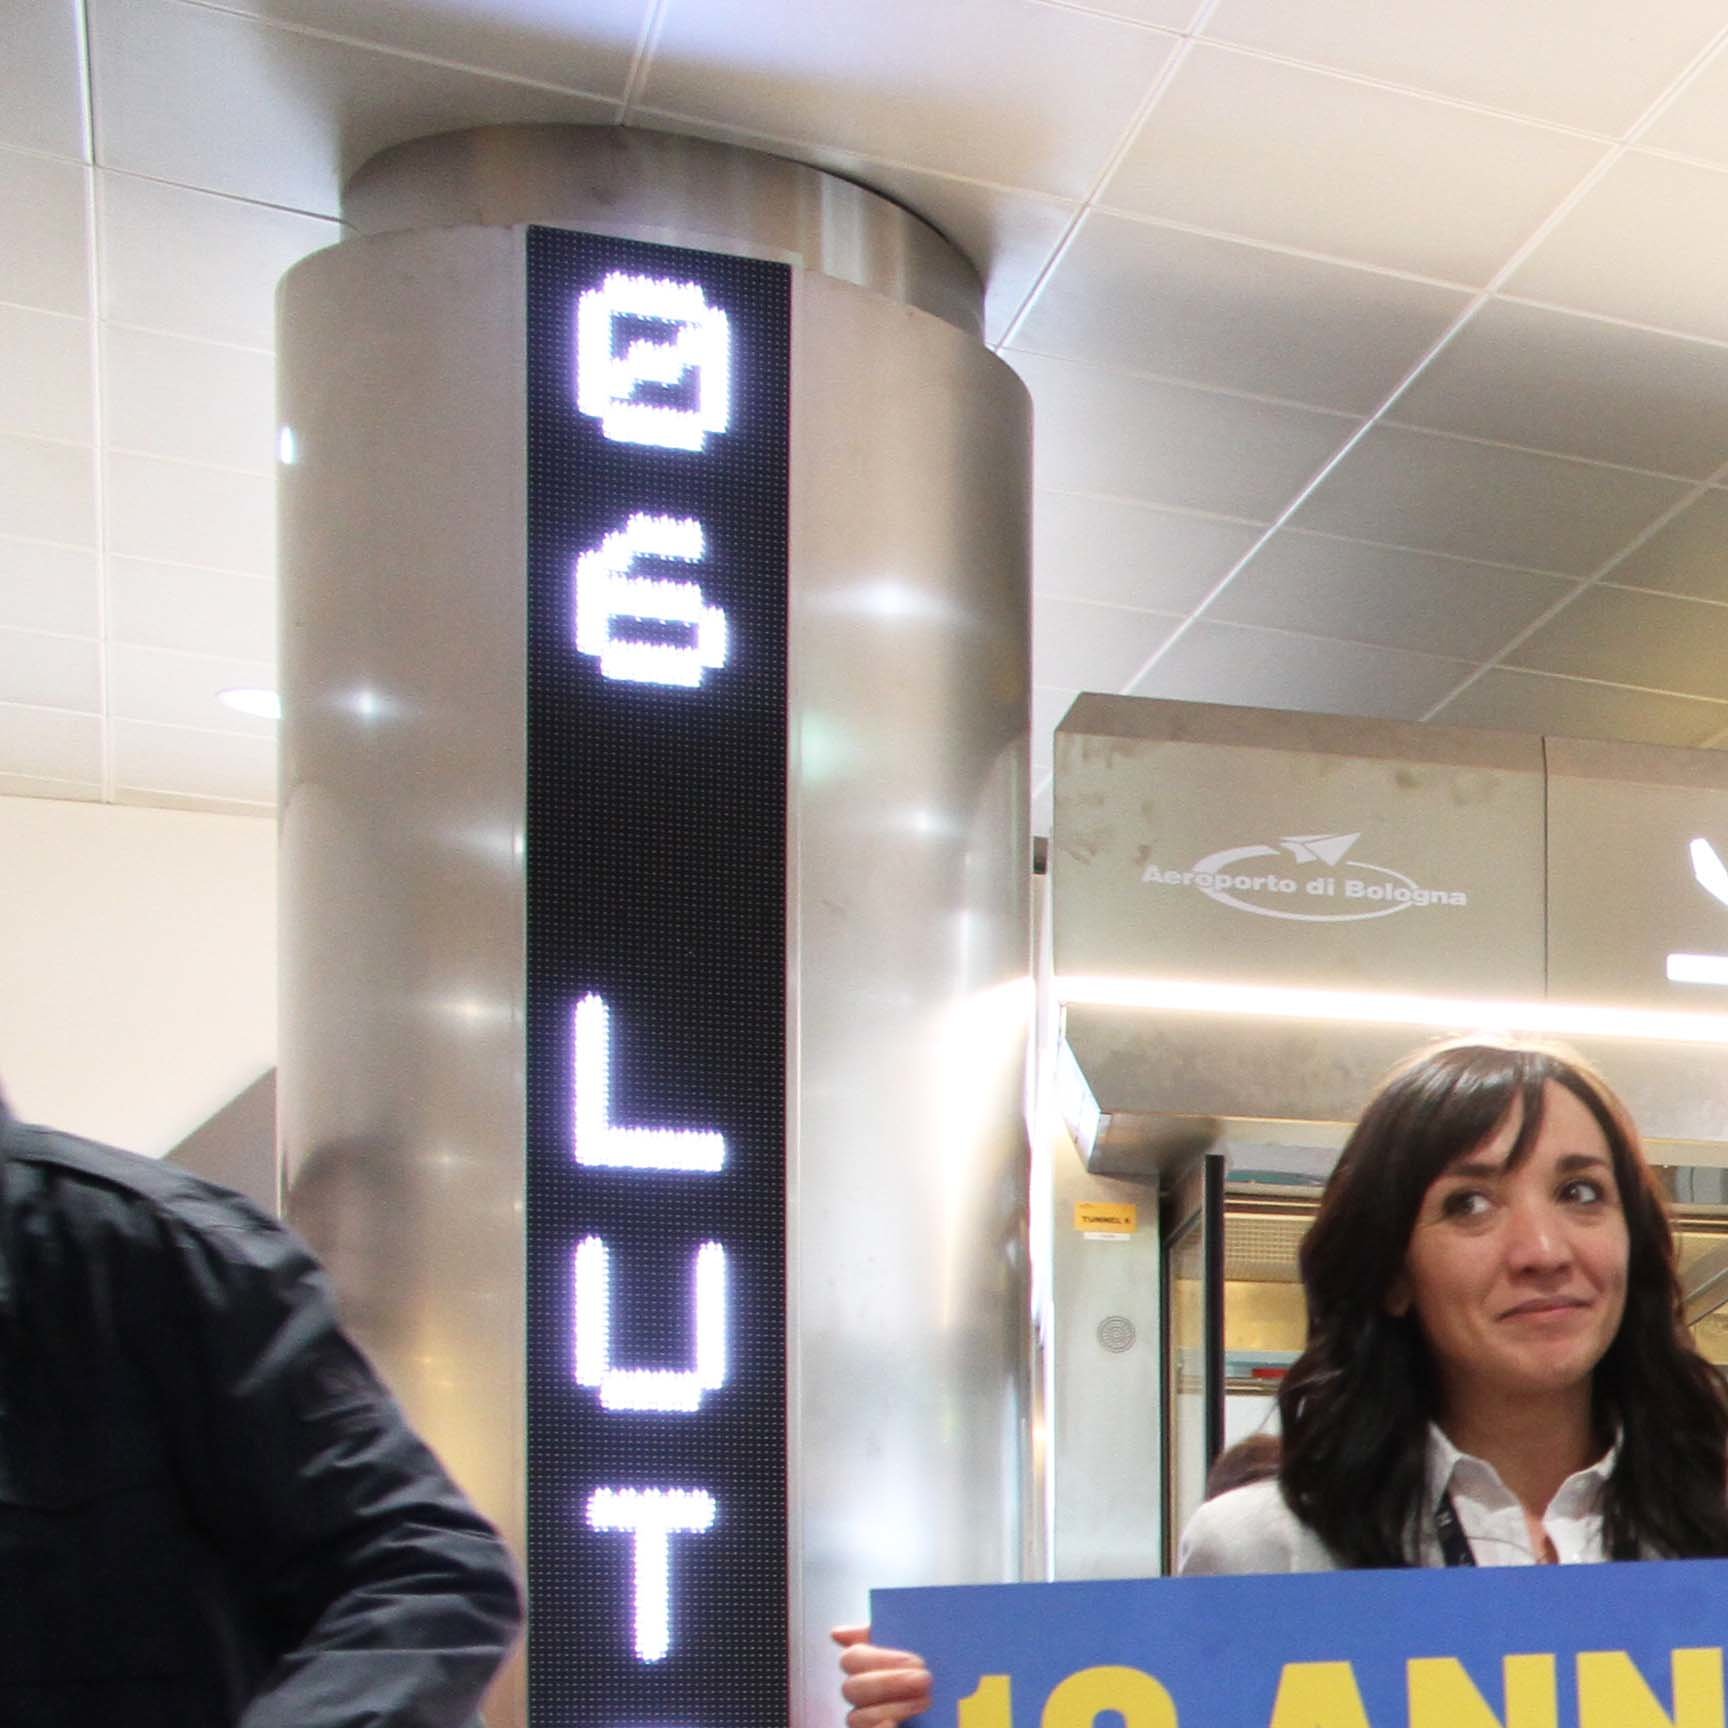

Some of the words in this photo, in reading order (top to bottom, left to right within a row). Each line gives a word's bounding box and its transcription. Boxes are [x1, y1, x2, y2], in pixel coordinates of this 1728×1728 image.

[1142, 862, 1297, 893] Aeroporto
[1305, 876, 1334, 897] di
[1344, 879, 1467, 907] Bologna
